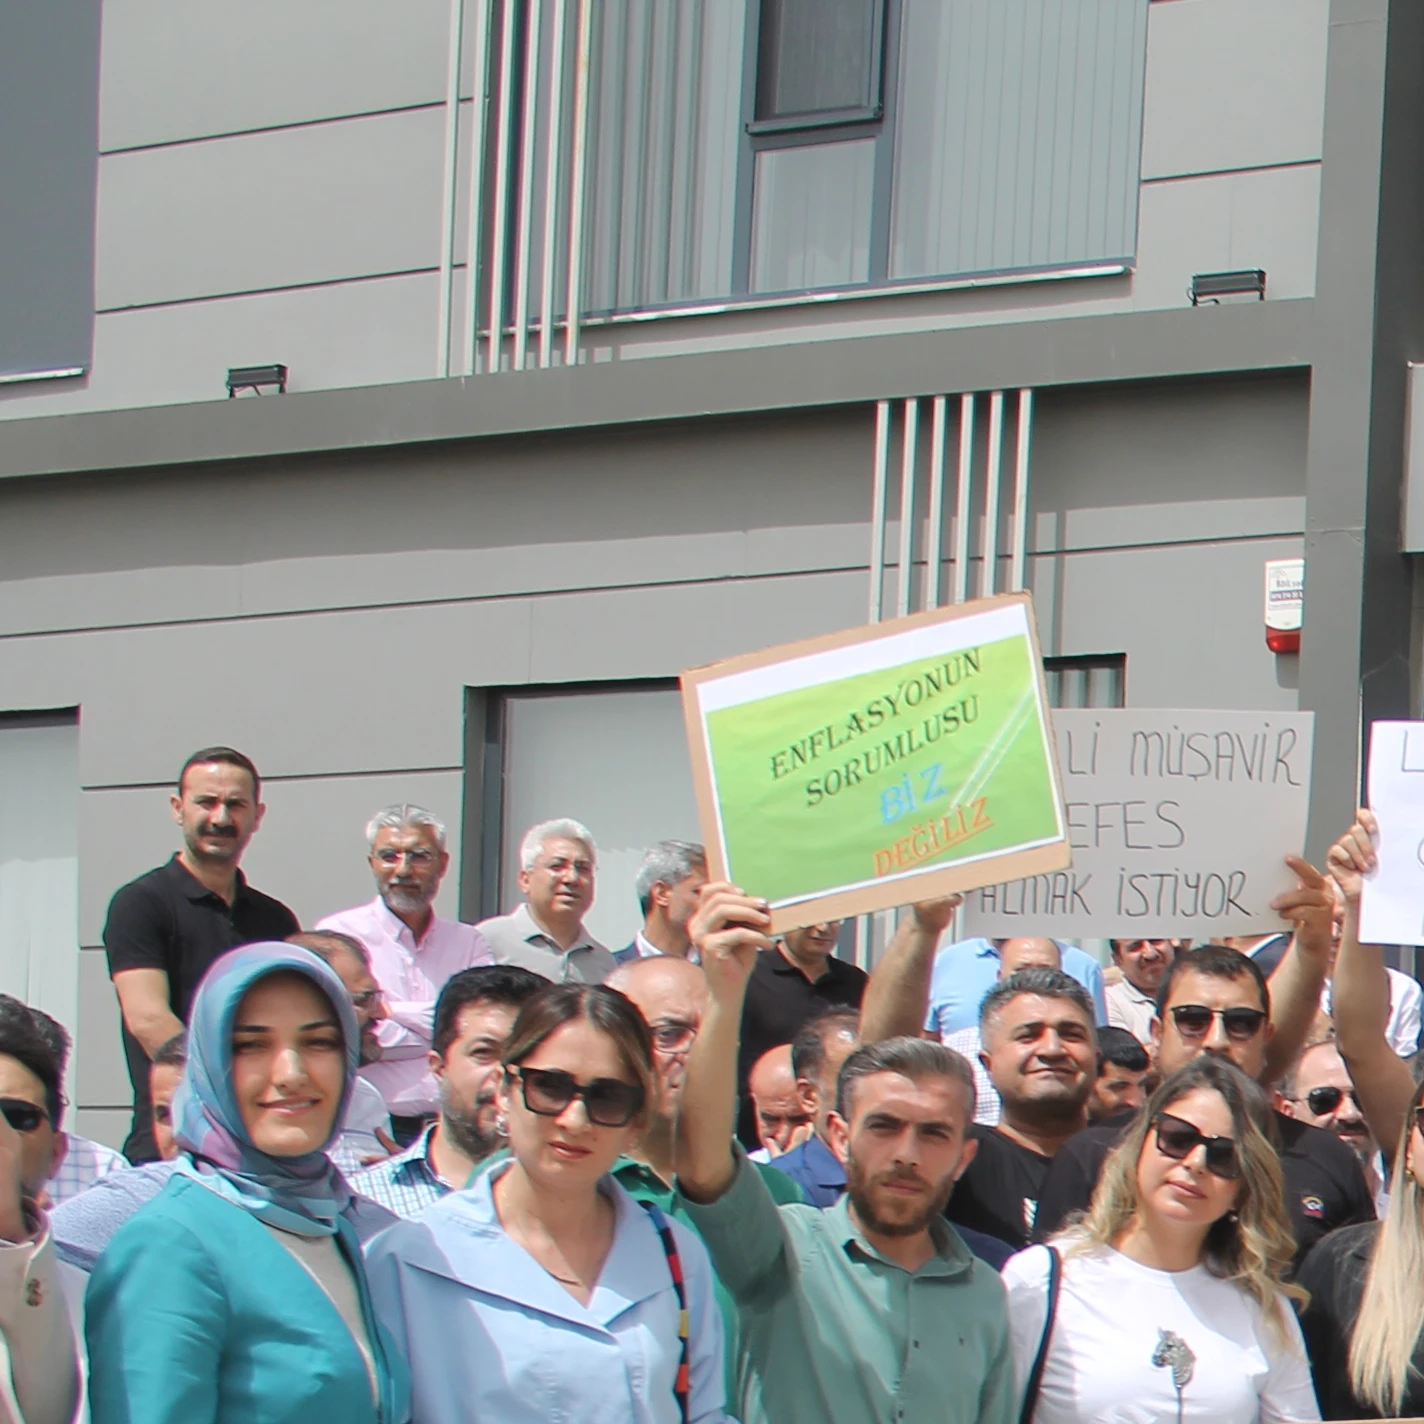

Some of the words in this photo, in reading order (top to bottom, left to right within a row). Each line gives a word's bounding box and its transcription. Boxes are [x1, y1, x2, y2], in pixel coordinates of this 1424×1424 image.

[770, 647, 982, 781] ENFLASYONUN
[806, 694, 979, 807] SORUMLUSU
[880, 763, 949, 826] BİZ
[1066, 800, 1185, 850] EFES
[873, 797, 992, 876] DEĞİLİZ
